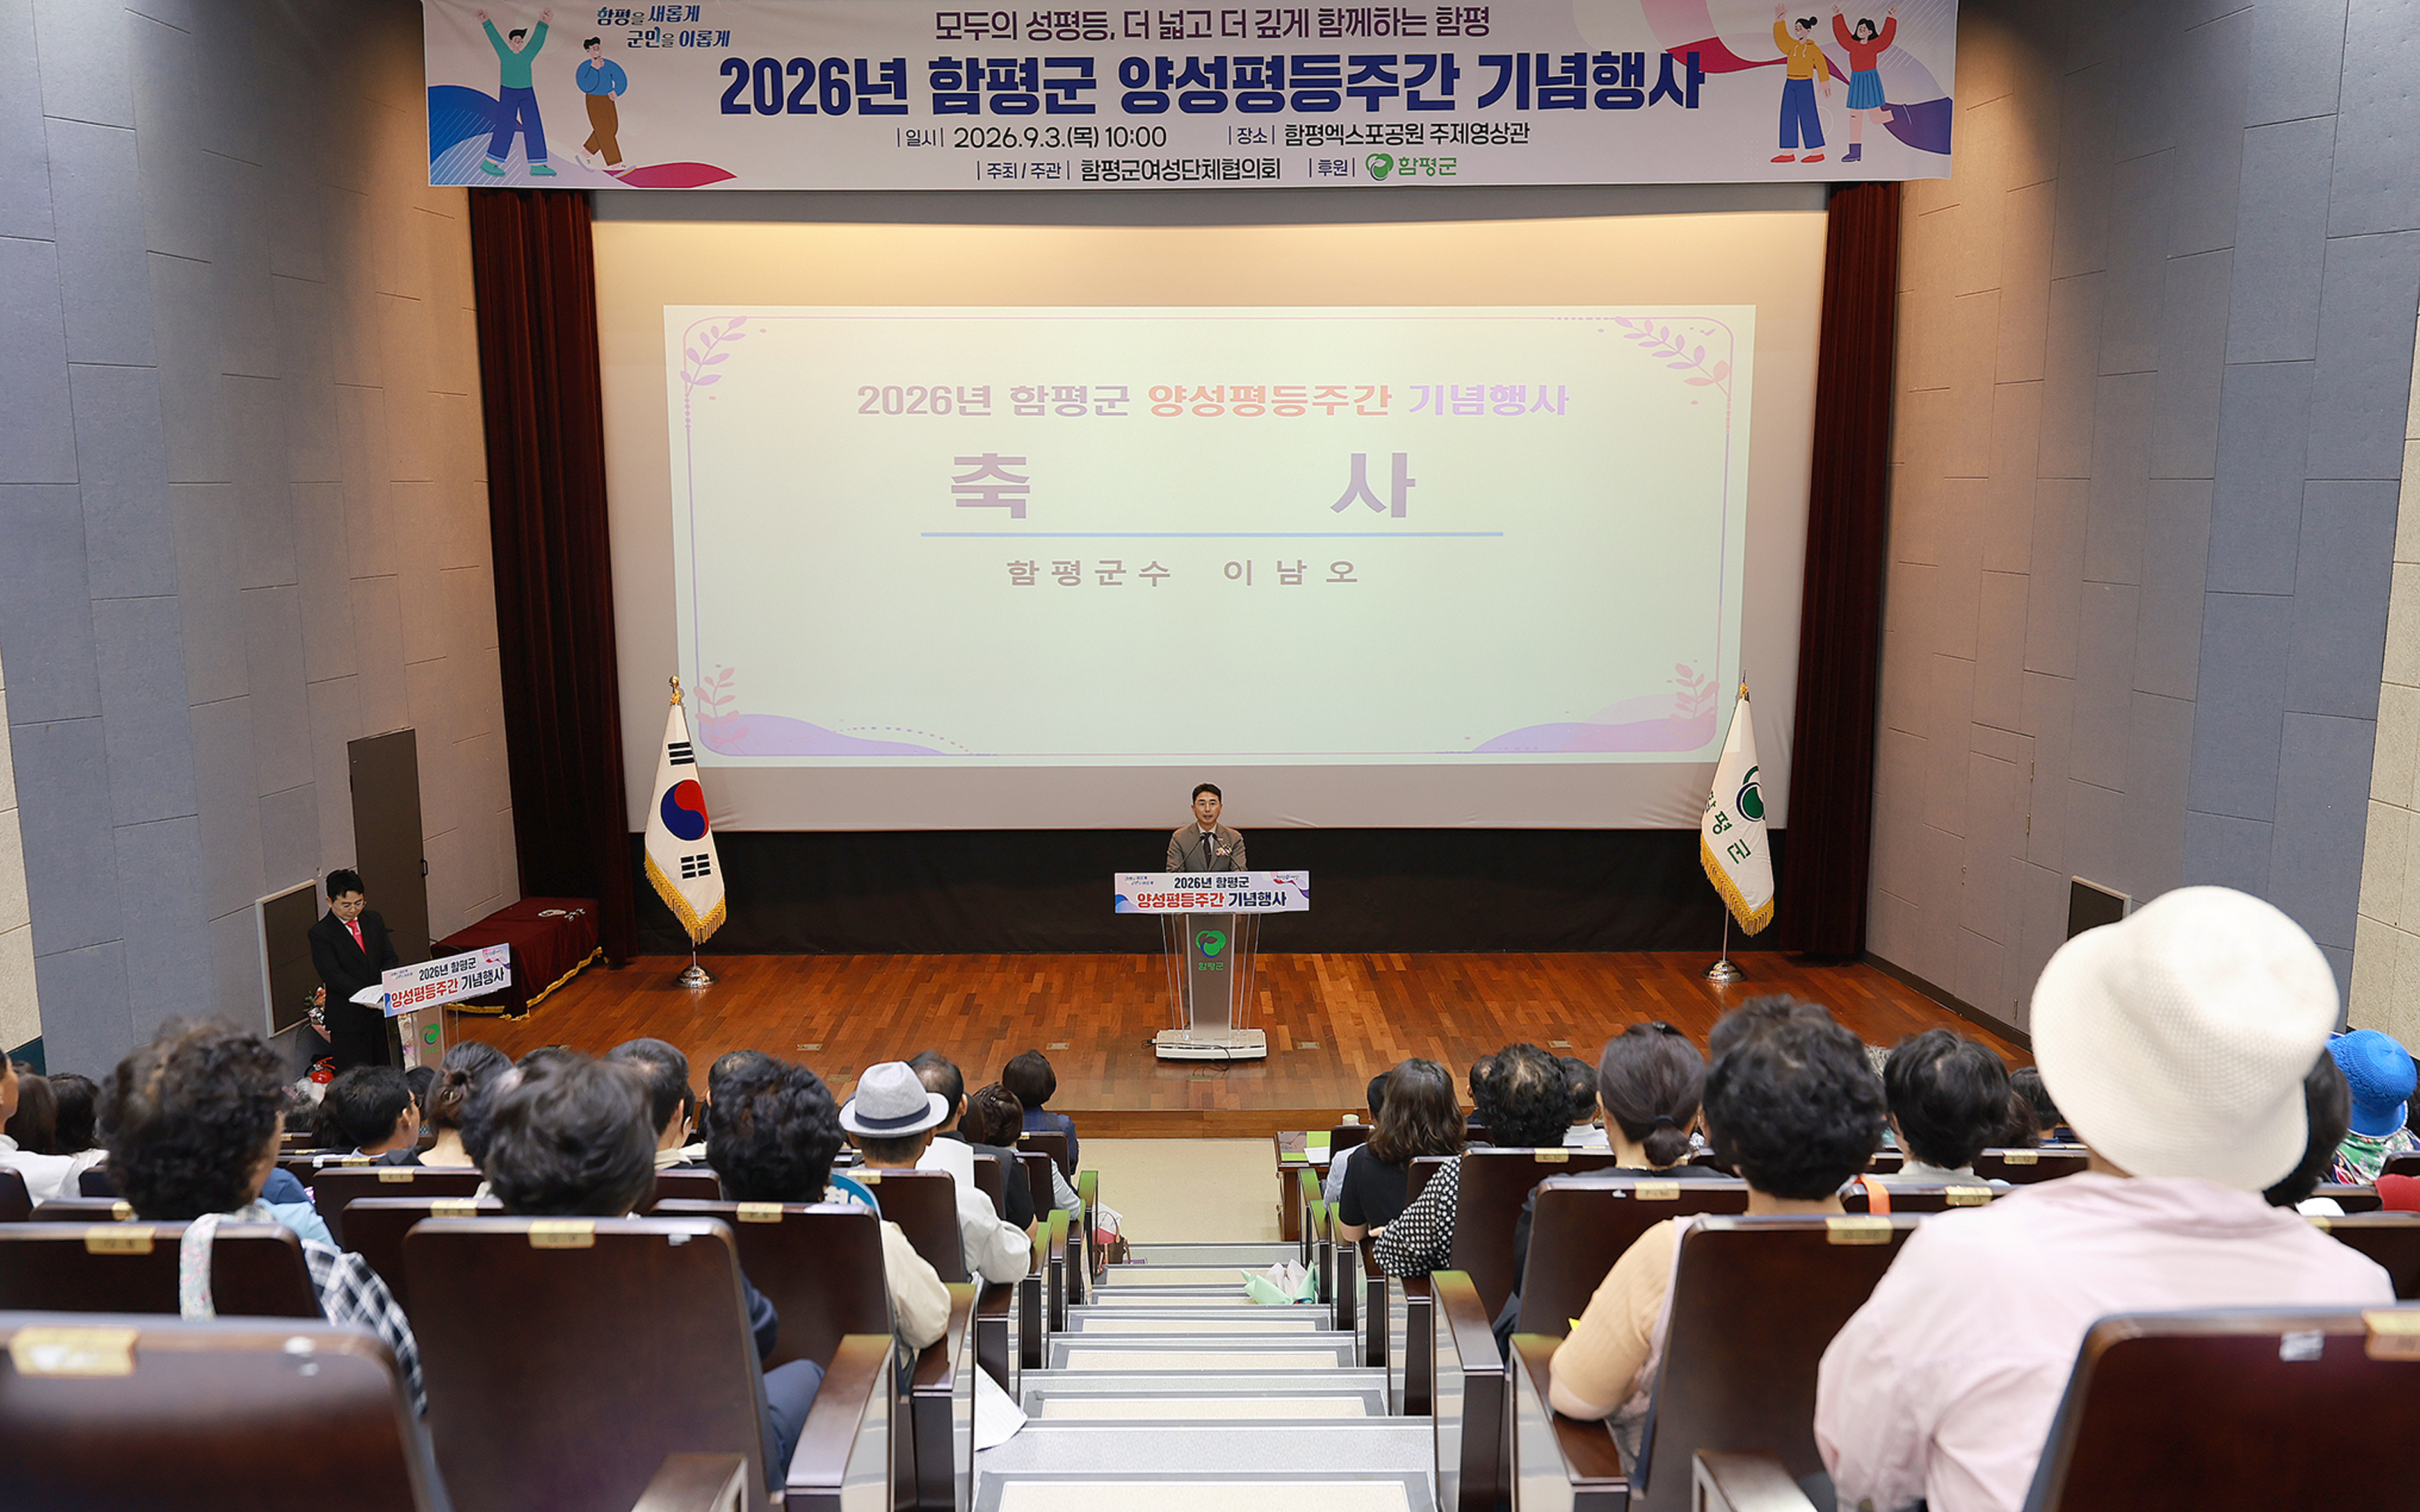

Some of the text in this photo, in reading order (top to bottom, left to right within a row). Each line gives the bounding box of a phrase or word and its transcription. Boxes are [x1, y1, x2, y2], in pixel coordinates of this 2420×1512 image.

[597, 5, 700, 26] 함평을 새롭게
[937, 6, 1489, 41] 모두의 성평등, 더 넓고 더 깊게 함께하는 함평
[627, 26, 730, 48] 군민을 이롭게
[720, 51, 1704, 115] 2026년 함평군 양성평등주간 기념행사
[906, 122, 1530, 148] 일시 2026.9.3.(목) 10:00 장소 함평엑스포공원 주제영상관
[987, 163, 1017, 179] 주최
[1031, 163, 1061, 179] 주관
[1081, 158, 1280, 181] 함평군여성단체협의회
[1318, 159, 1348, 176] 후원
[1399, 157, 1456, 176] 함평군
[858, 382, 1569, 419] 2026년 함평군 양성평등주간 기념행사
[951, 453, 1416, 519] 축 사
[1007, 560, 1357, 587] 함평군수 이남오
[1175, 877, 1249, 889] 2026년 함평군
[1138, 892, 1286, 908] 양성평등주간 기념행사
[419, 963, 448, 981] 2026년
[451, 957, 476, 974] 함평군
[391, 967, 504, 1008] 양성평등주간 기념행사
